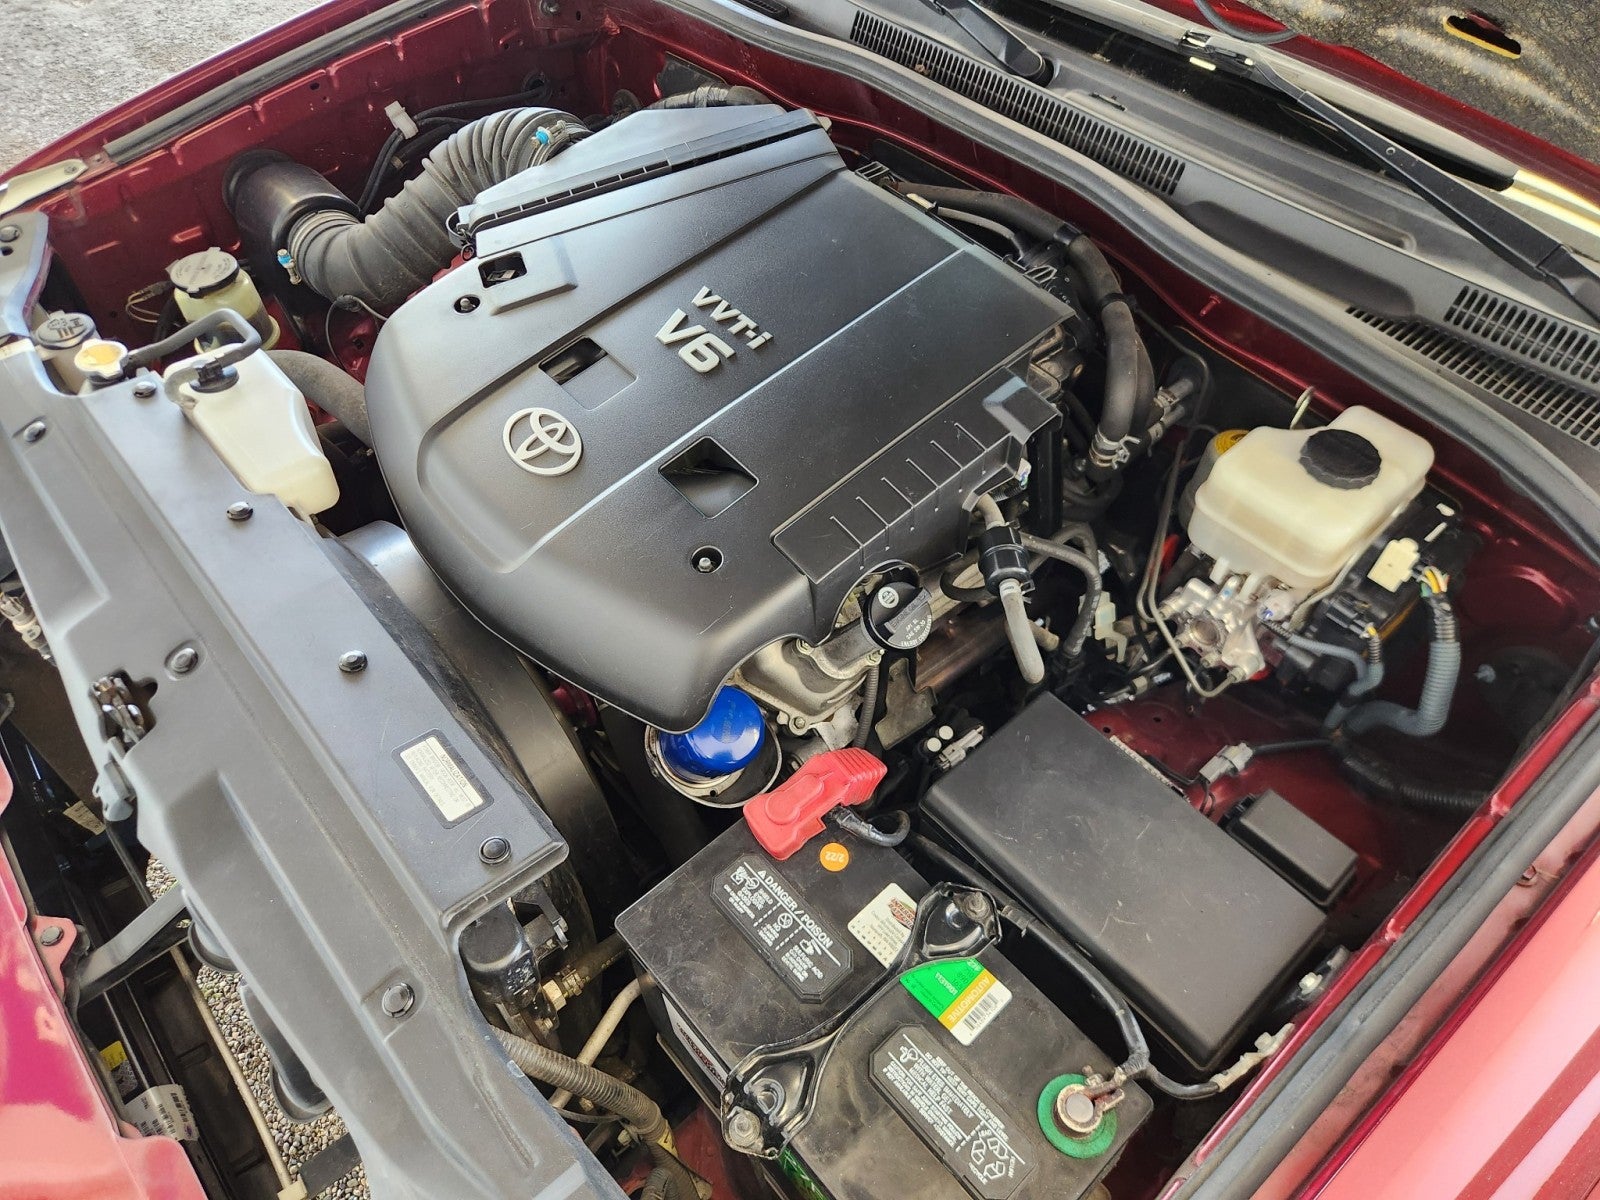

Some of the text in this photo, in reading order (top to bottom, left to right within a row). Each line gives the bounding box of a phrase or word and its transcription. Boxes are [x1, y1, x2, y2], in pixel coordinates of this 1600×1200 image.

[655, 308, 735, 372] V6
[824, 850, 843, 862] 2/22
[740, 886, 763, 910] EXPLOSIVE
[757, 887, 774, 905] SHIELD
[764, 875, 798, 911] DANGER
[800, 913, 833, 948] POISON
[771, 922, 781, 932] NO
[791, 944, 814, 968] SULFURIC
[945, 975, 992, 1023] AUTOMOTIVE
[908, 1067, 952, 1115] MEDICAL HELP FAST
[912, 1062, 926, 1077] WITH
[940, 1092, 952, 1104] GET
[916, 1057, 975, 1120] FLUSH EYES IMMEDIATELY
